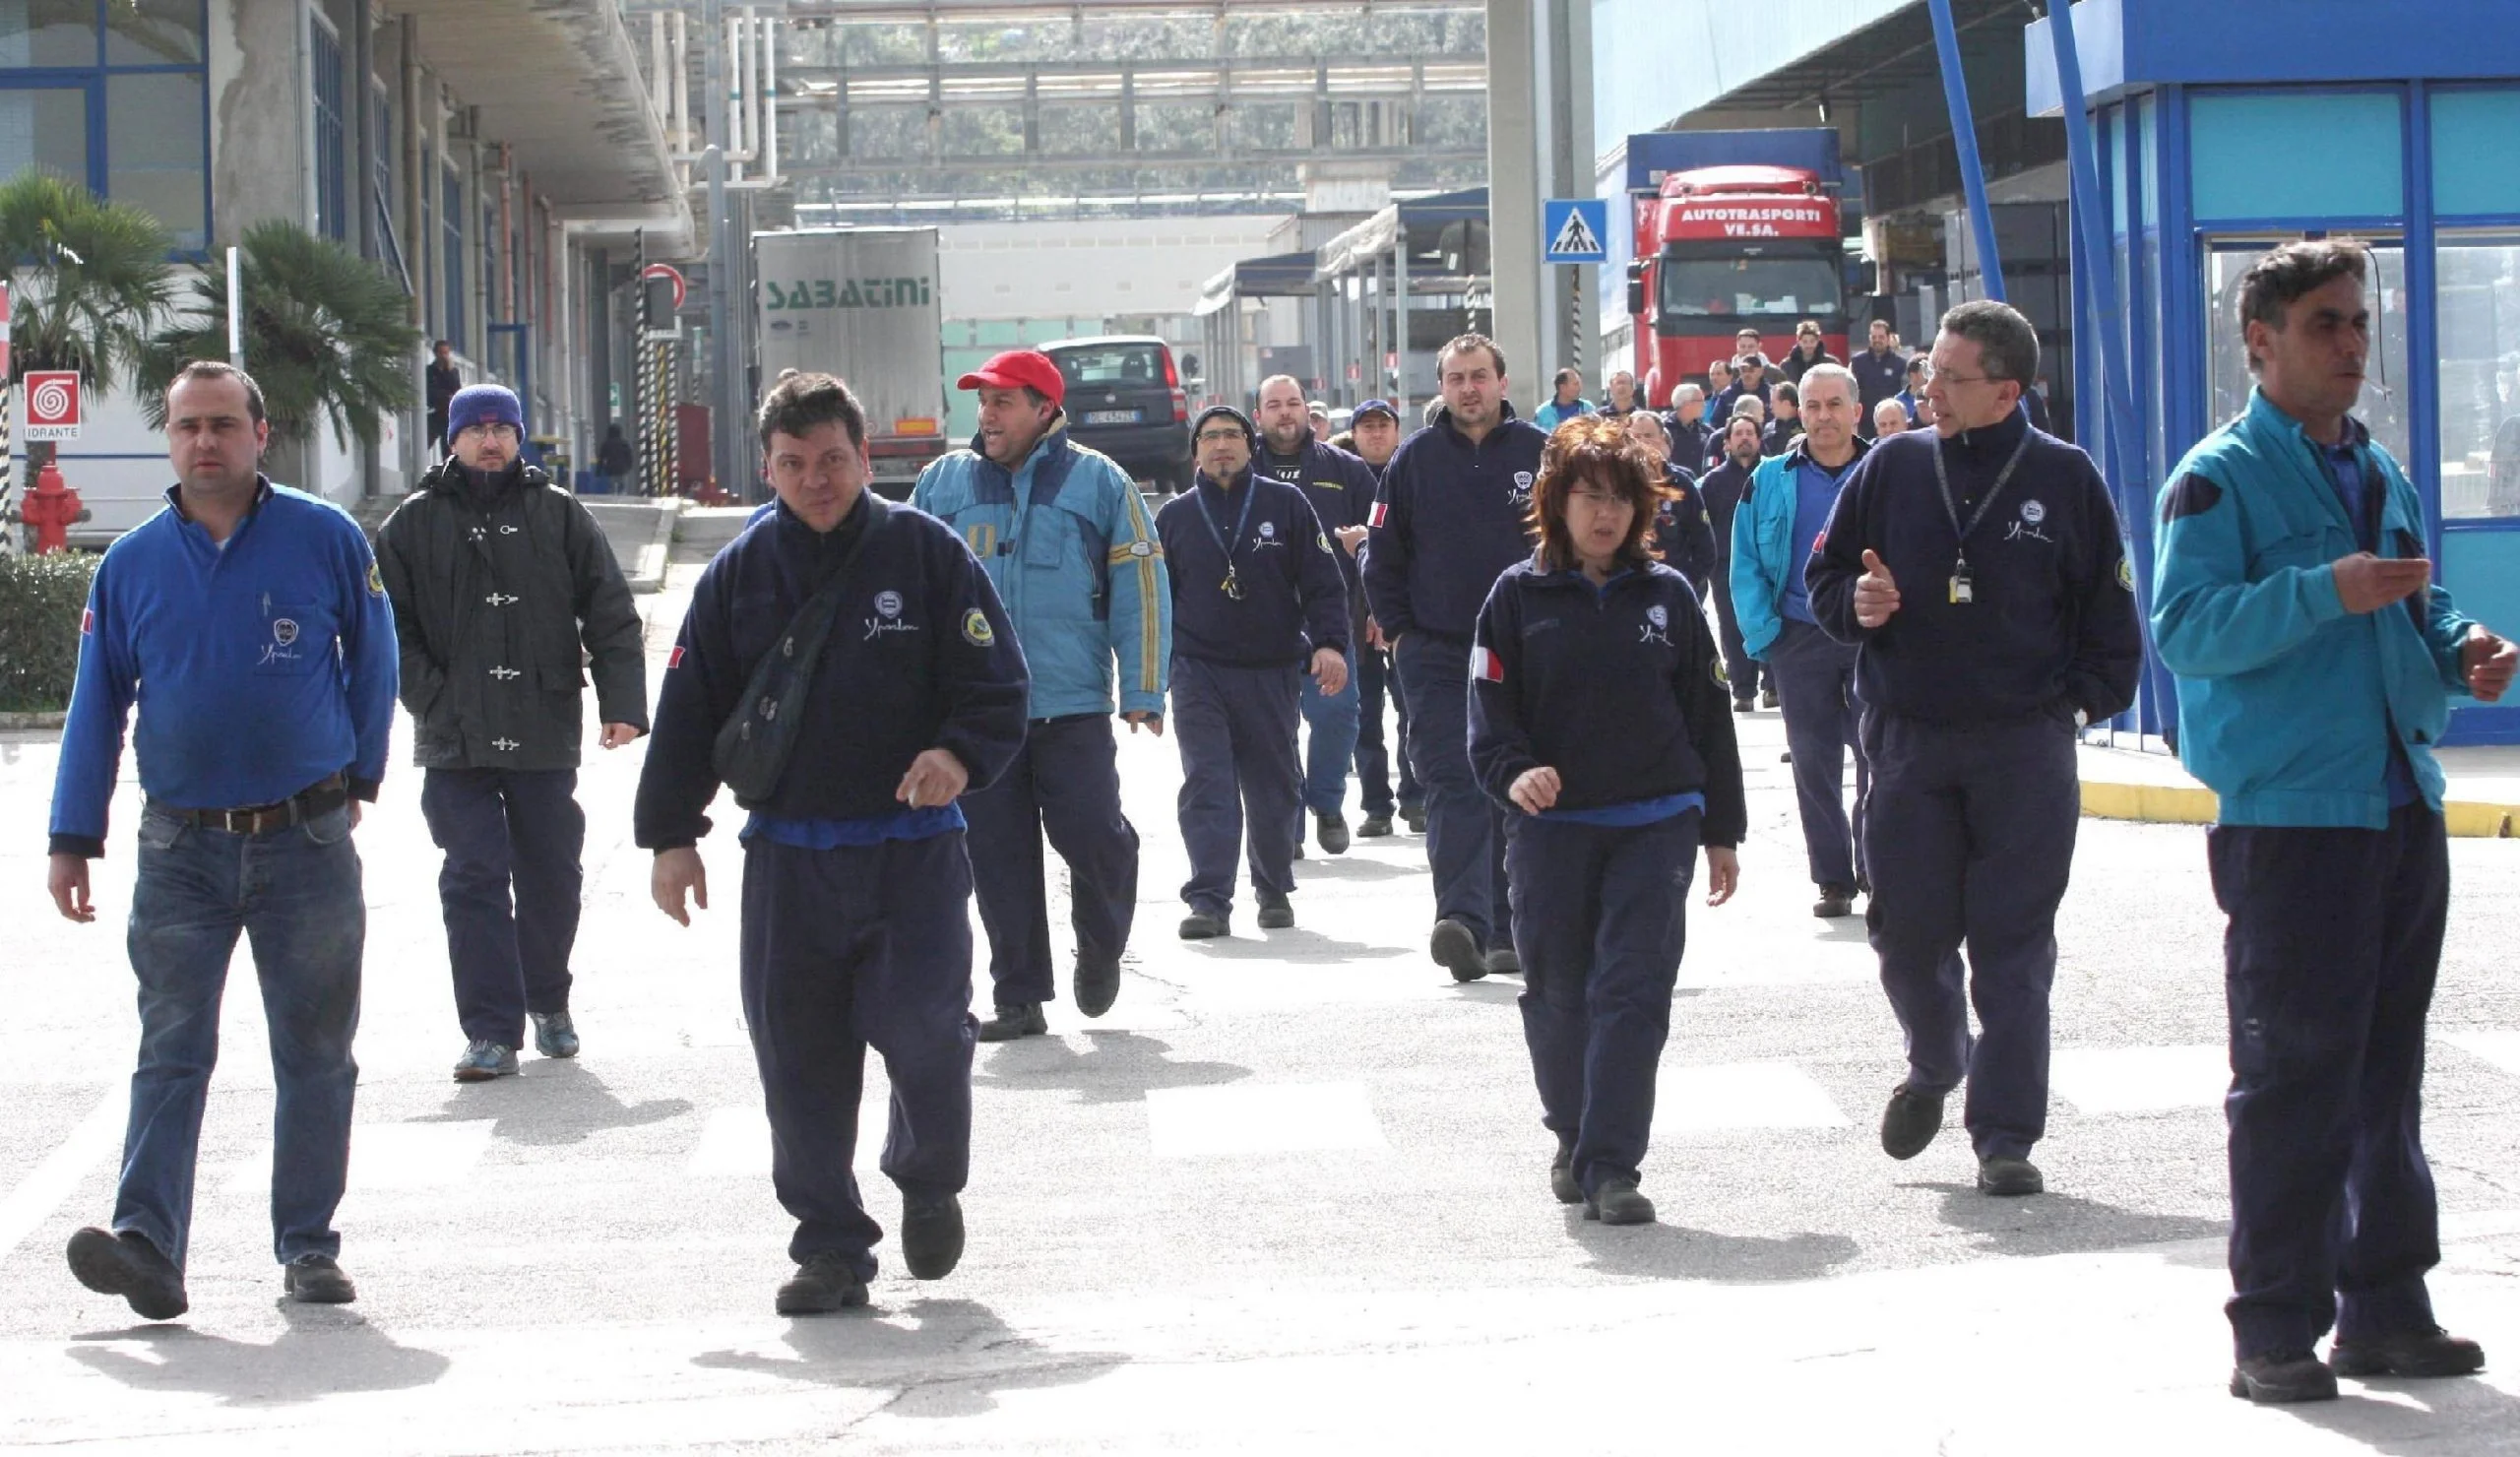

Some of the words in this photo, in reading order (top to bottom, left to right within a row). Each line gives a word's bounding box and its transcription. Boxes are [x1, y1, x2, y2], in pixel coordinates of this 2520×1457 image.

[1681, 208, 1821, 222] AUTOTRASPORTI
[1724, 222, 1780, 237] VE.SA.
[27, 426, 79, 438] IDRANTE
